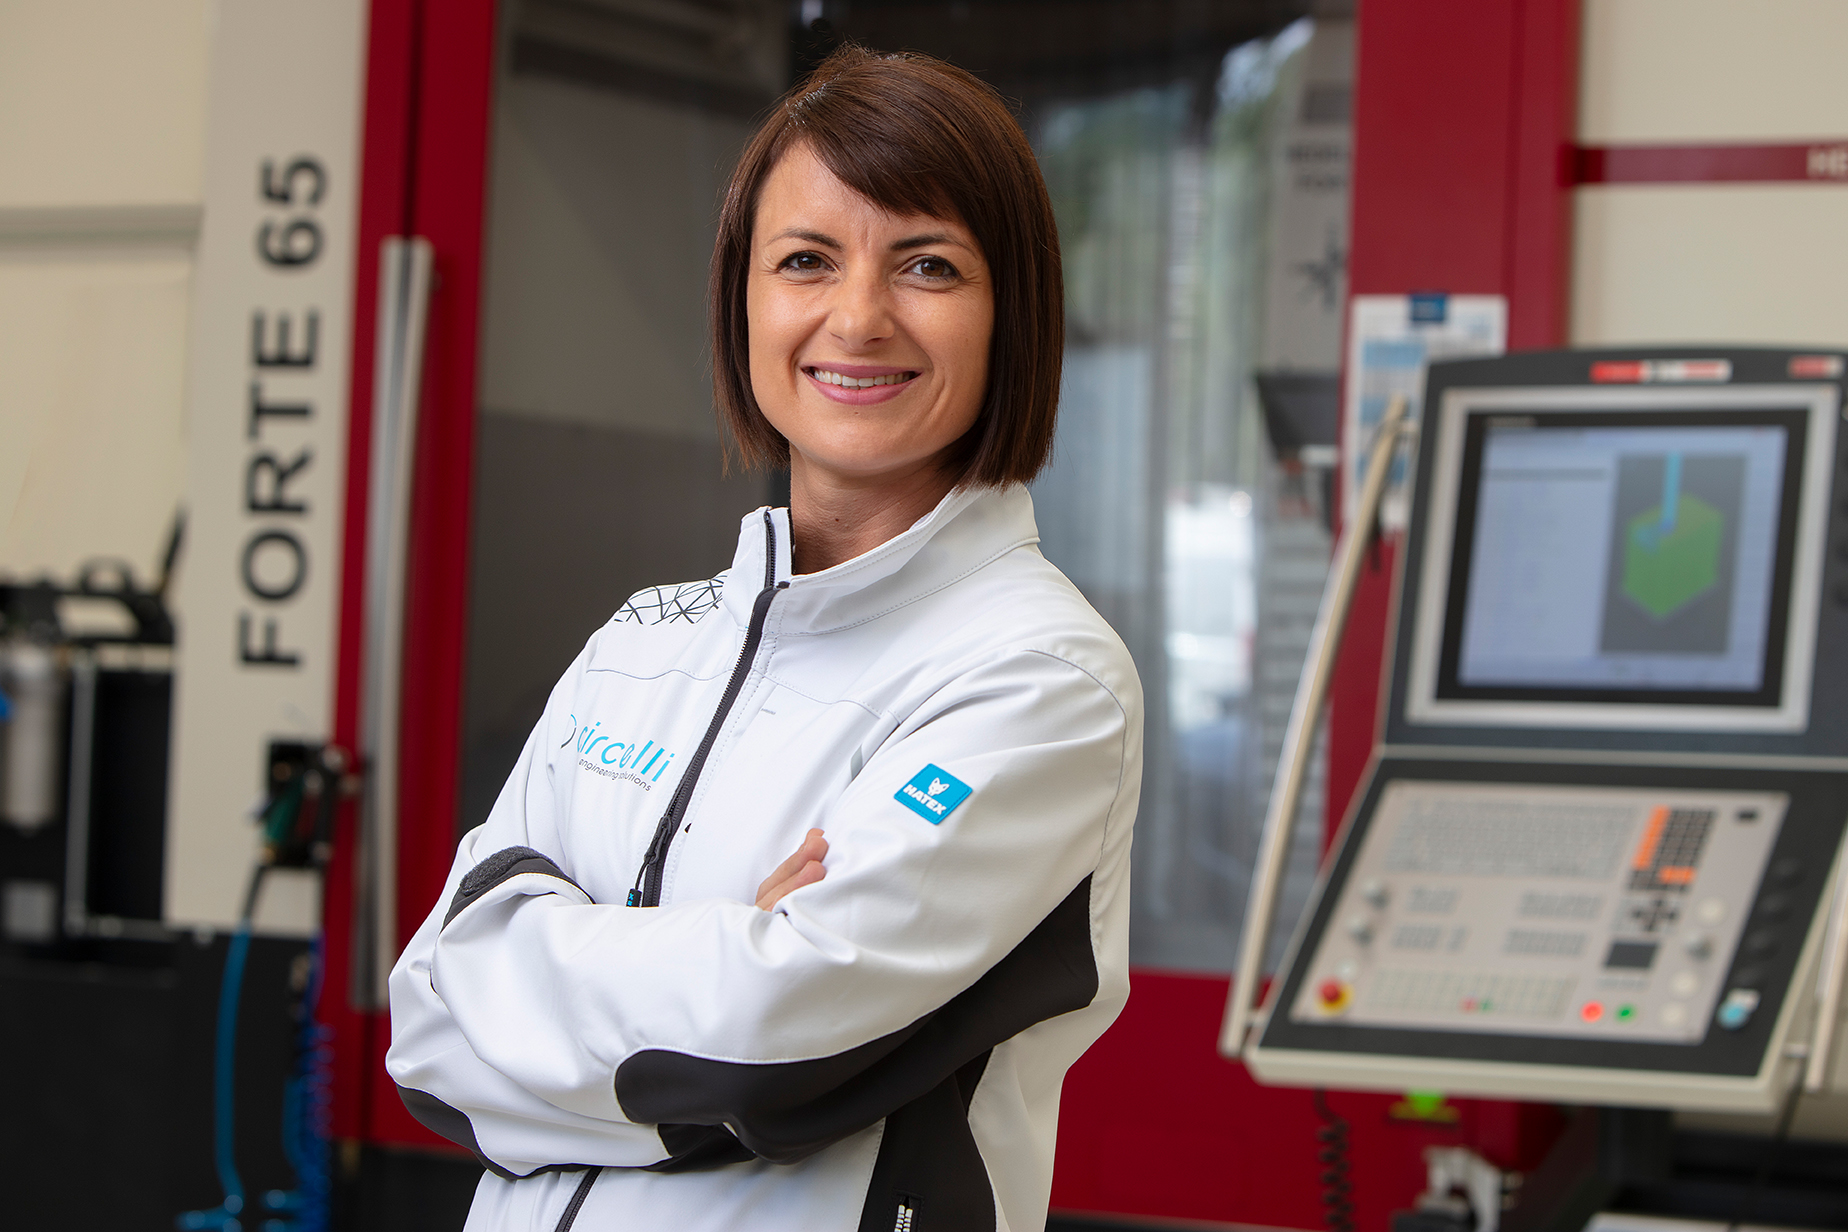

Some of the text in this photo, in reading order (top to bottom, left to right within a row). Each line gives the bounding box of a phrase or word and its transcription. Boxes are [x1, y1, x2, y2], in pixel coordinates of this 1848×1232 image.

[238, 153, 329, 668] FORTE 65
[578, 758, 619, 780] engineering
[903, 784, 947, 815] HATEX
